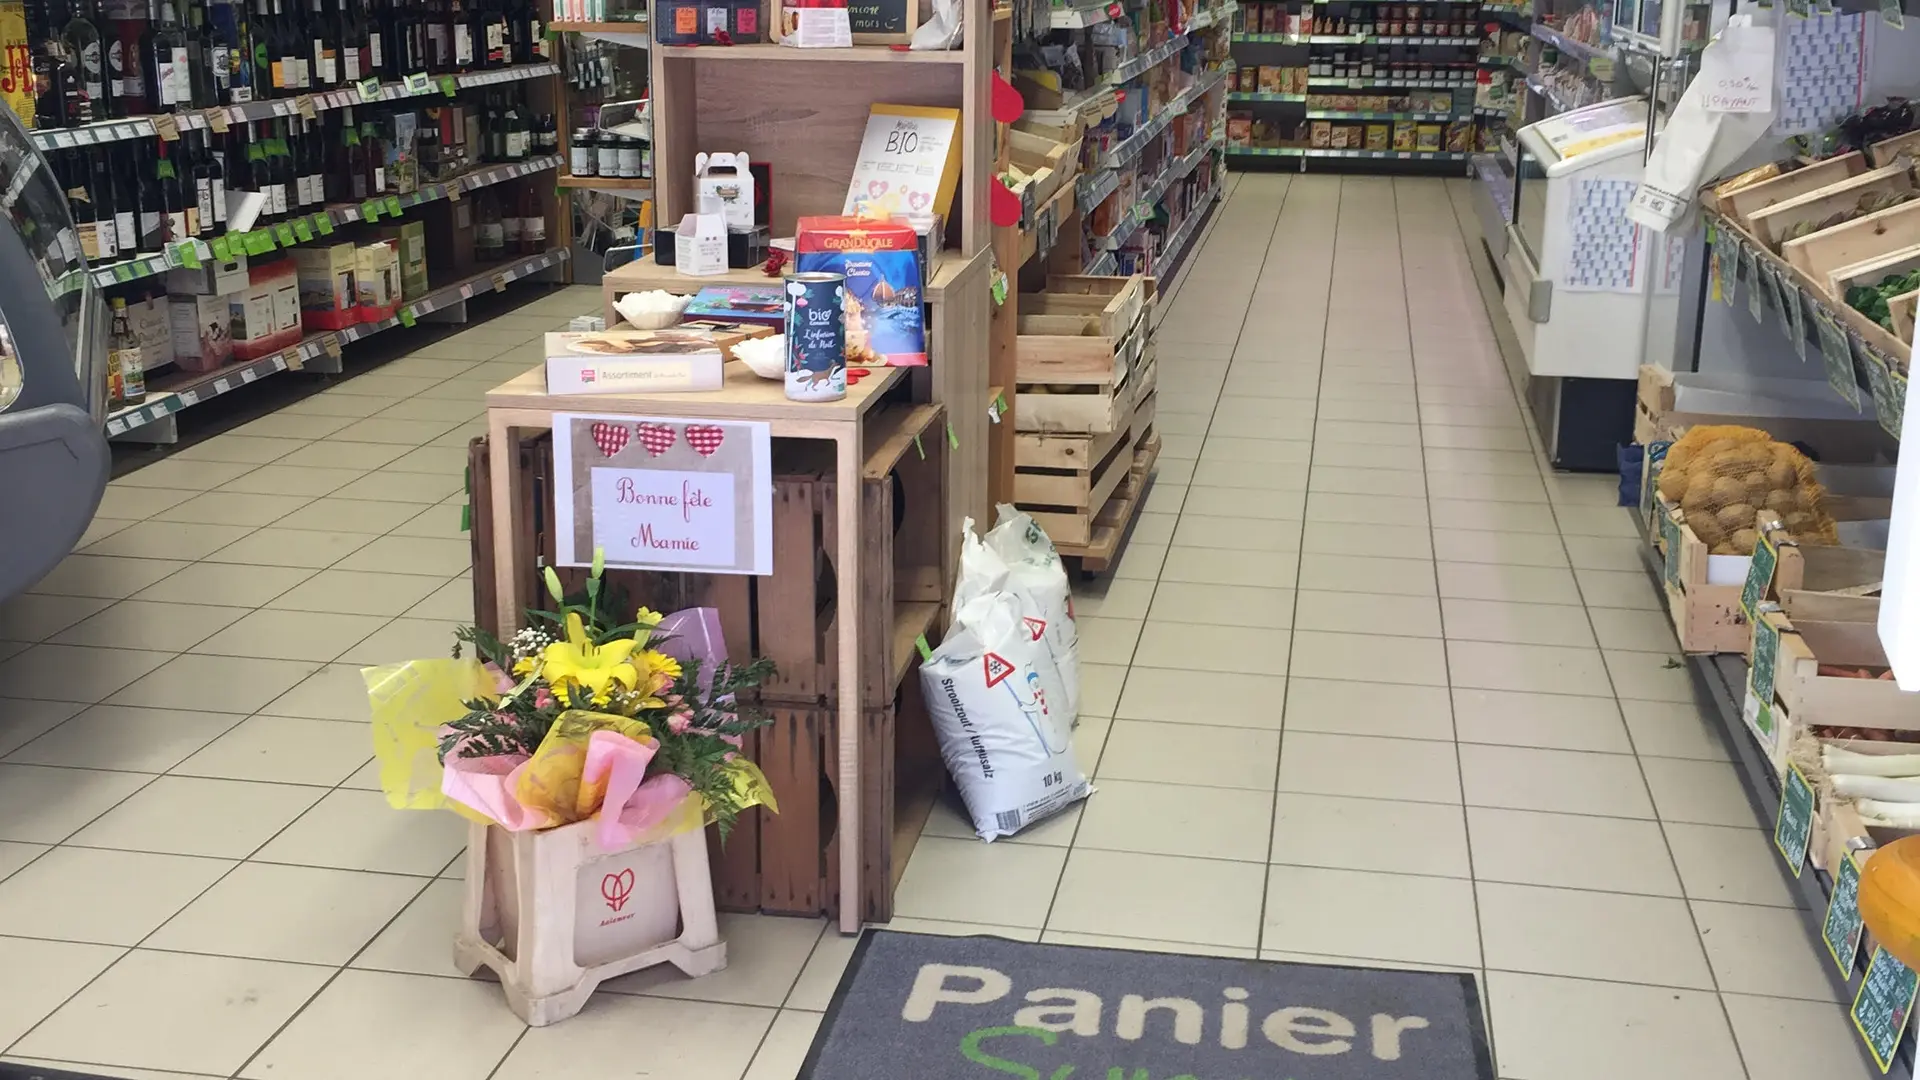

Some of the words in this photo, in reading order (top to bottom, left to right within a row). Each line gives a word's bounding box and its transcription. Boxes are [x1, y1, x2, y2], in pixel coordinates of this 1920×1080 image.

[885, 130, 919, 155] BIO
[808, 308, 831, 321] bio
[602, 371, 652, 380] Assortiment
[616, 477, 678, 505] Bonne
[683, 479, 712, 523] fête
[631, 523, 700, 551] Mamie
[941, 678, 973, 728] Strooizout
[1043, 773, 1053, 787] 10
[1053, 771, 1063, 785] kg
[902, 962, 1430, 1061] Panier
